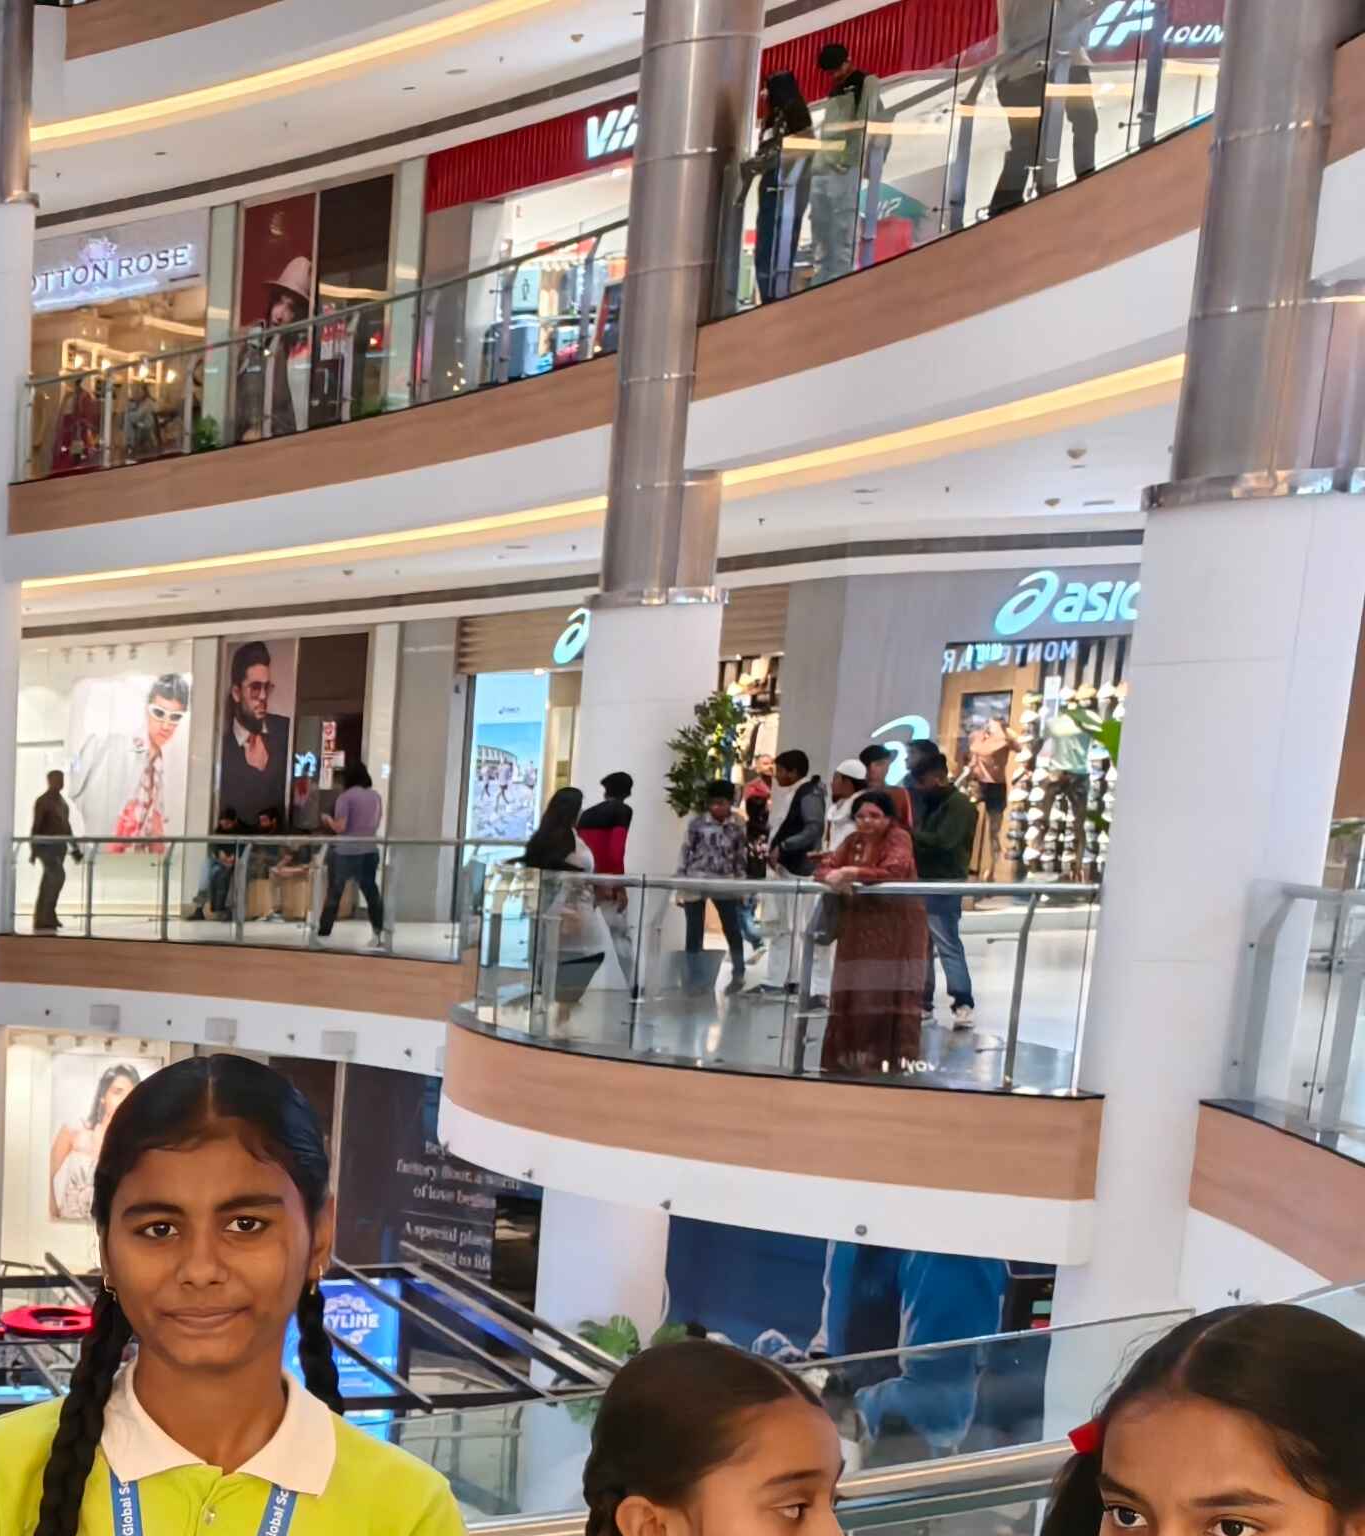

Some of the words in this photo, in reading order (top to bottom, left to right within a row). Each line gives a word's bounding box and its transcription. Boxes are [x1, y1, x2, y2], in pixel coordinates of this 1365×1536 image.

[1163, 24, 1226, 44] LOUN
[32, 259, 110, 296] TTON
[118, 245, 192, 279] ROSE
[1053, 581, 1142, 624] asic
[122, 1497, 135, 1536] Global
